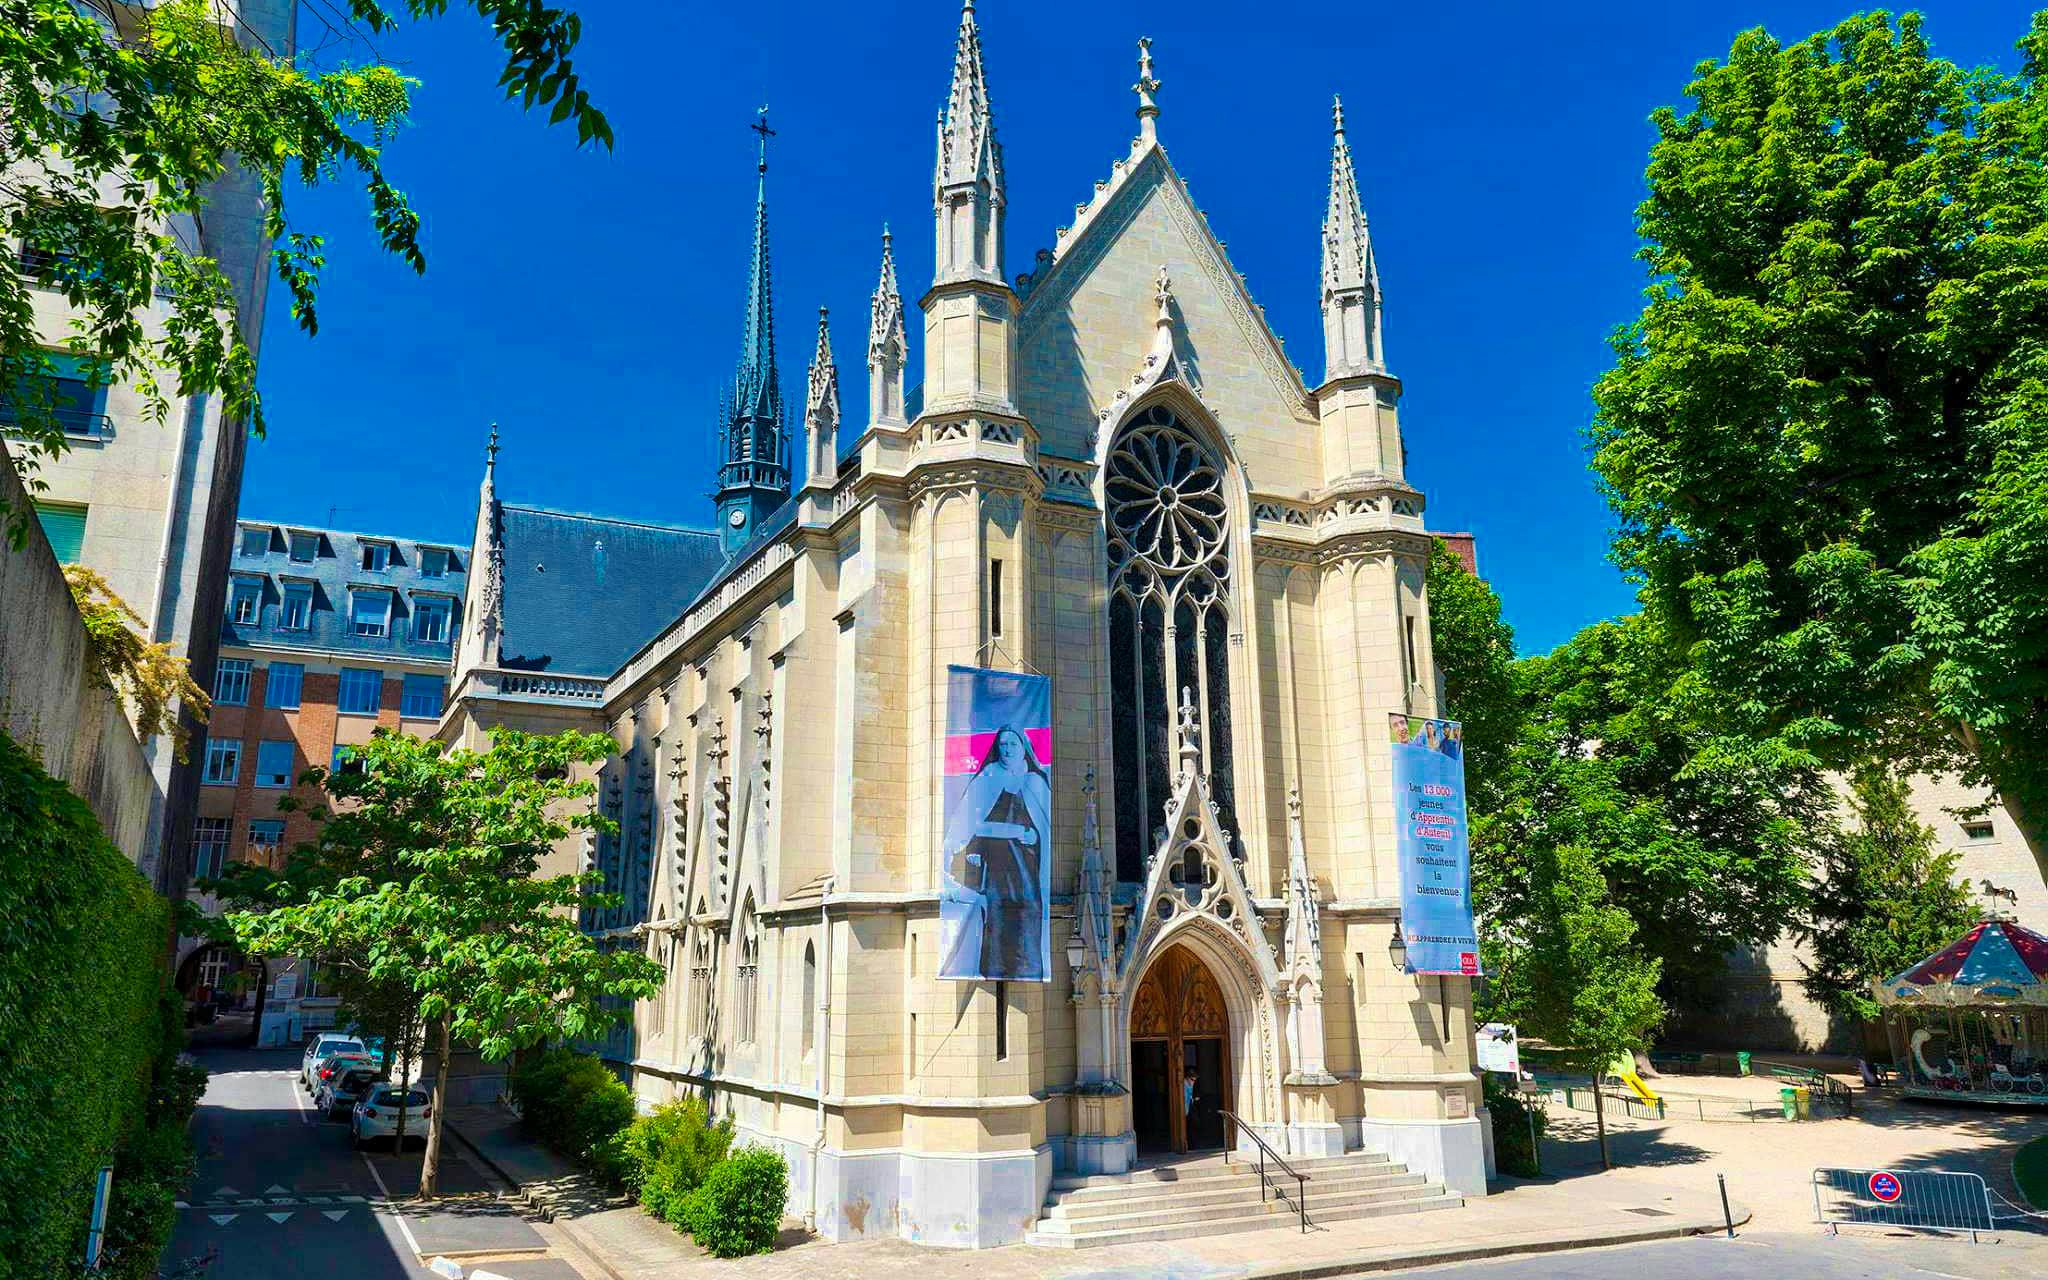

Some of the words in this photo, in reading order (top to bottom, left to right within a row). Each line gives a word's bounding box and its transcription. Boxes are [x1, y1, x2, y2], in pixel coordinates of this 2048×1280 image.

[1409, 782, 1422, 793] Les
[1418, 799, 1444, 810] jeunes
[1416, 826, 1451, 839] d'Auteuil
[1426, 843, 1444, 852] vous
[1416, 856, 1457, 867] souhaitent
[1433, 871, 1442, 881] la
[1417, 884, 1462, 897] bienvenue.
